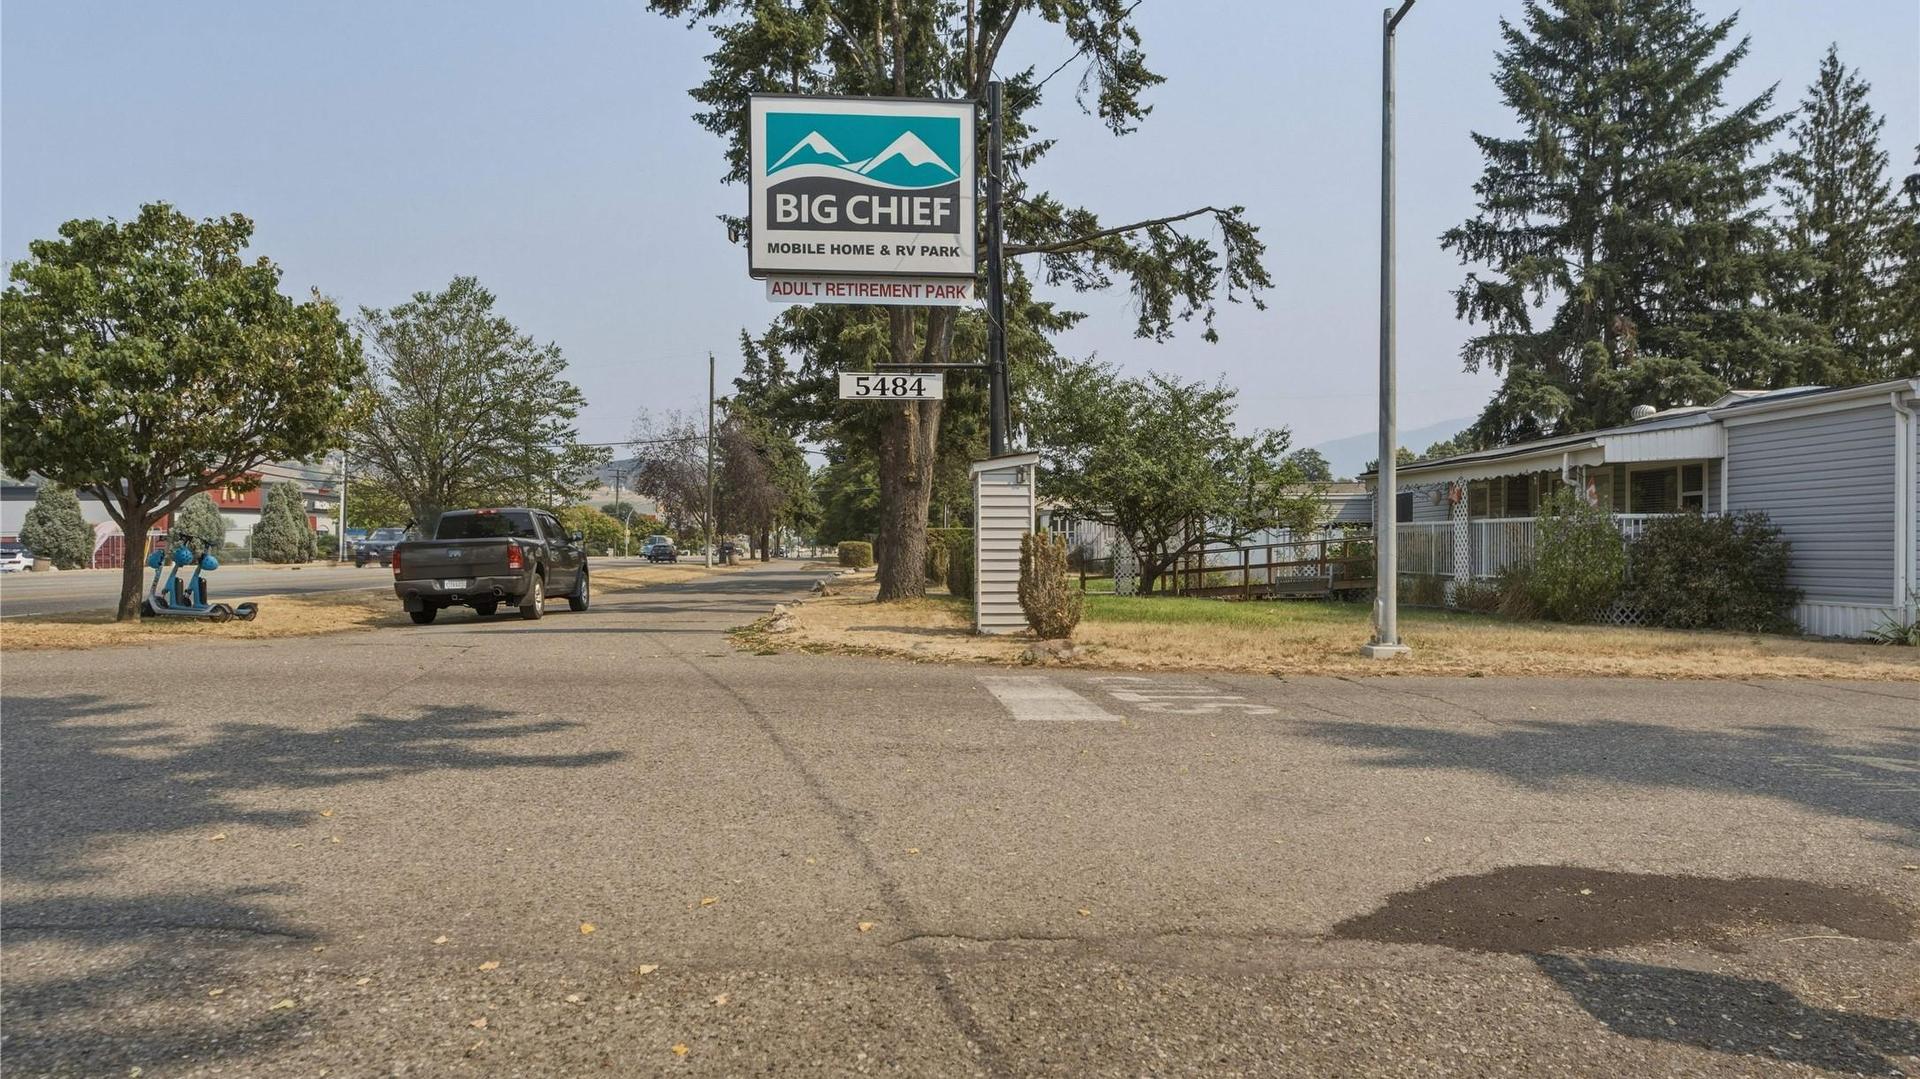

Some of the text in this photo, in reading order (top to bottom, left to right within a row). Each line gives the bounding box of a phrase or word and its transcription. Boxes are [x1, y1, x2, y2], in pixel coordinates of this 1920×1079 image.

[776, 193, 952, 226] BIG CHIEF
[767, 242, 961, 258] MOBILE HOME & RV PARK
[771, 281, 967, 300] ADULT RETIREMENT PARK
[855, 376, 927, 397] 5484
